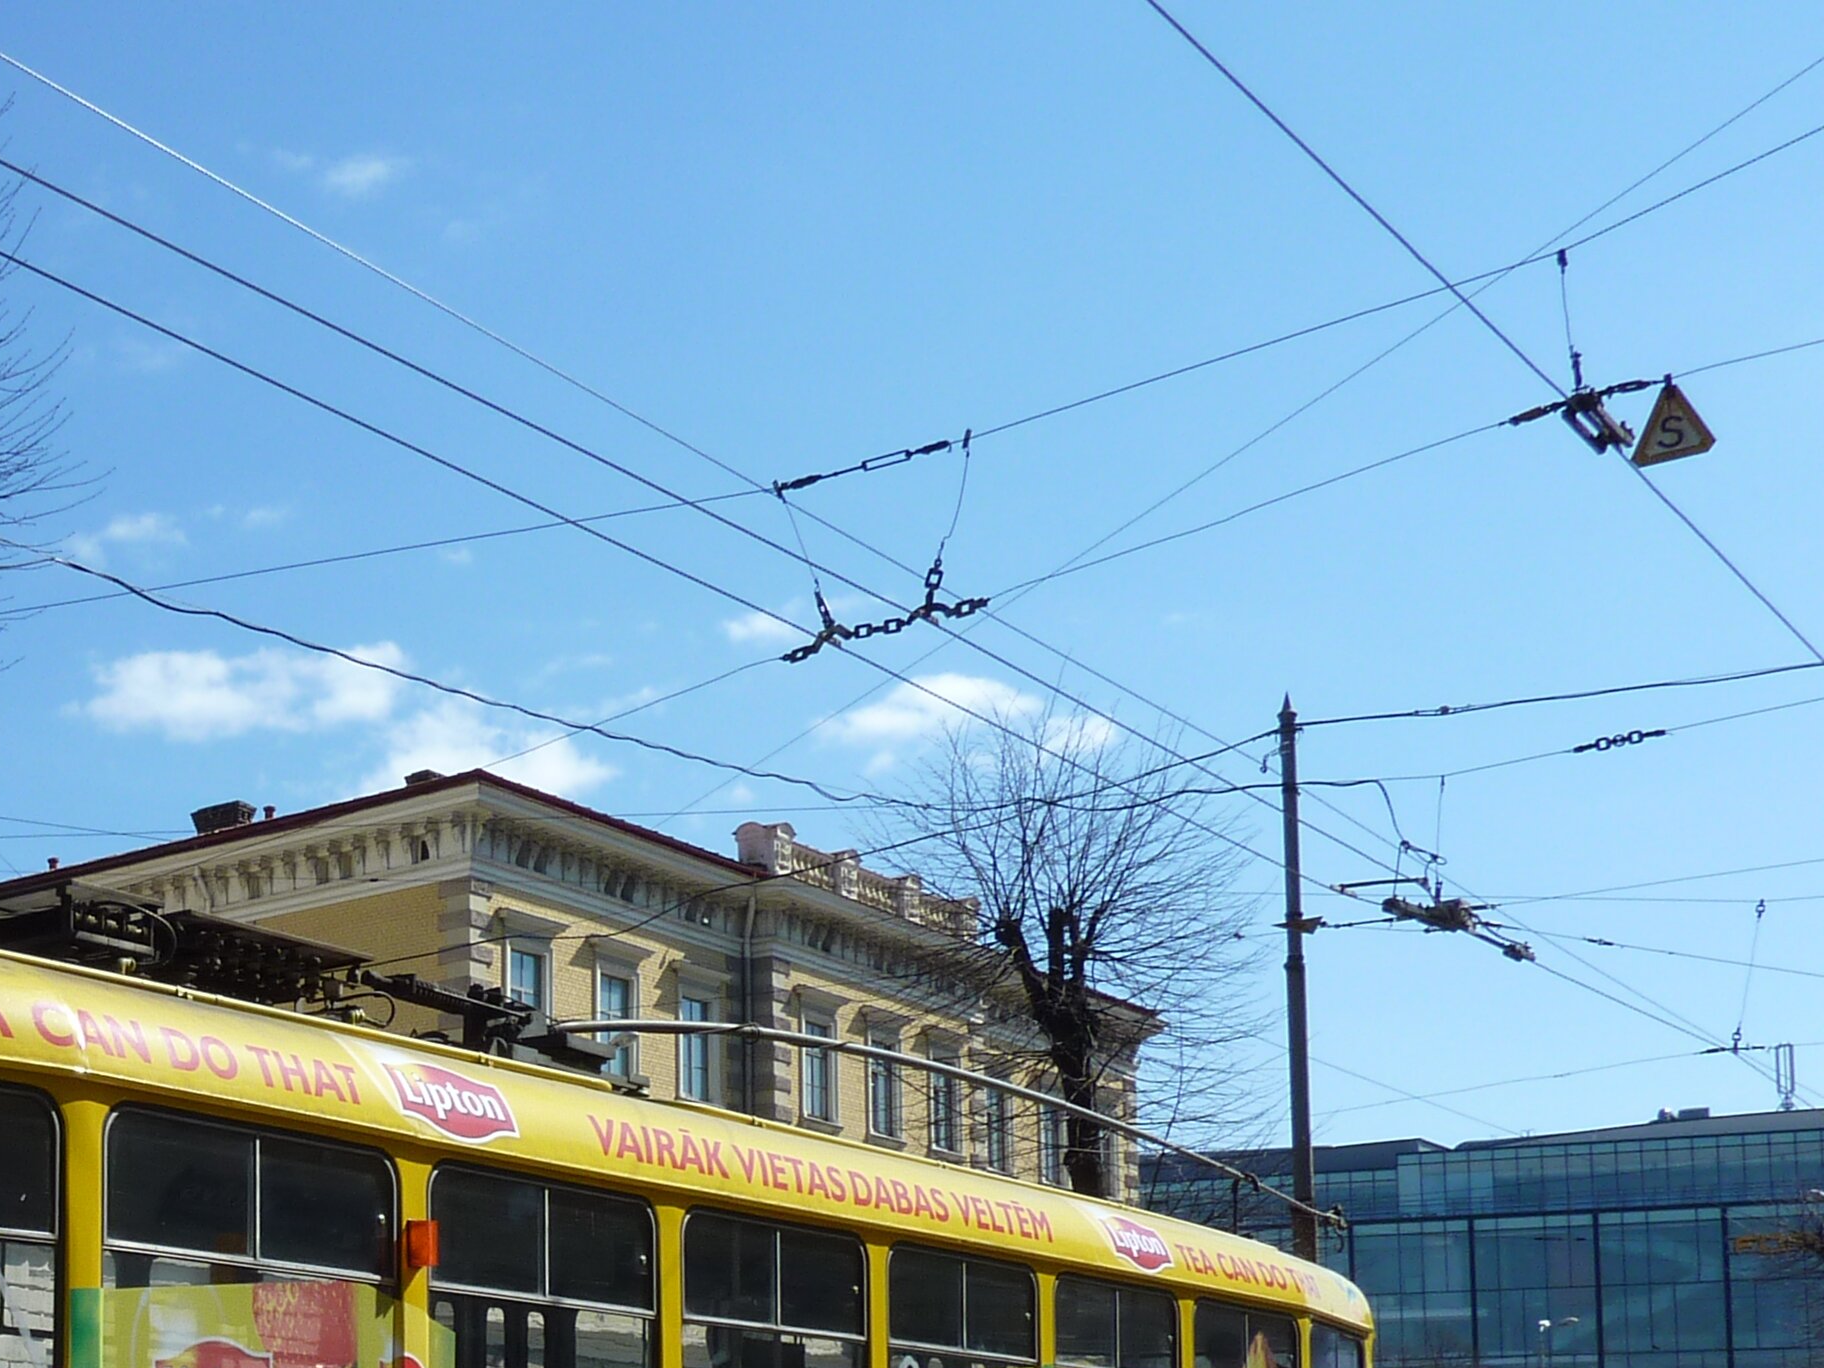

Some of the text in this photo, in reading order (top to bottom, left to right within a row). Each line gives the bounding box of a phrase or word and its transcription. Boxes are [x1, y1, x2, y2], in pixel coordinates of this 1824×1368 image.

[1658, 416, 1683, 448] S
[31, 1000, 152, 1064] CAN
[159, 1027, 239, 1080] DO
[246, 1044, 362, 1105] THAT
[394, 1068, 507, 1122] Lipton
[587, 1114, 1054, 1243] VAIRĀK VIETAS DABAS VELTĒM
[1106, 1223, 1167, 1257] Lipton
[1175, 1243, 1218, 1277] TEA
[1217, 1253, 1260, 1285] CAN
[1256, 1261, 1288, 1290] DO
